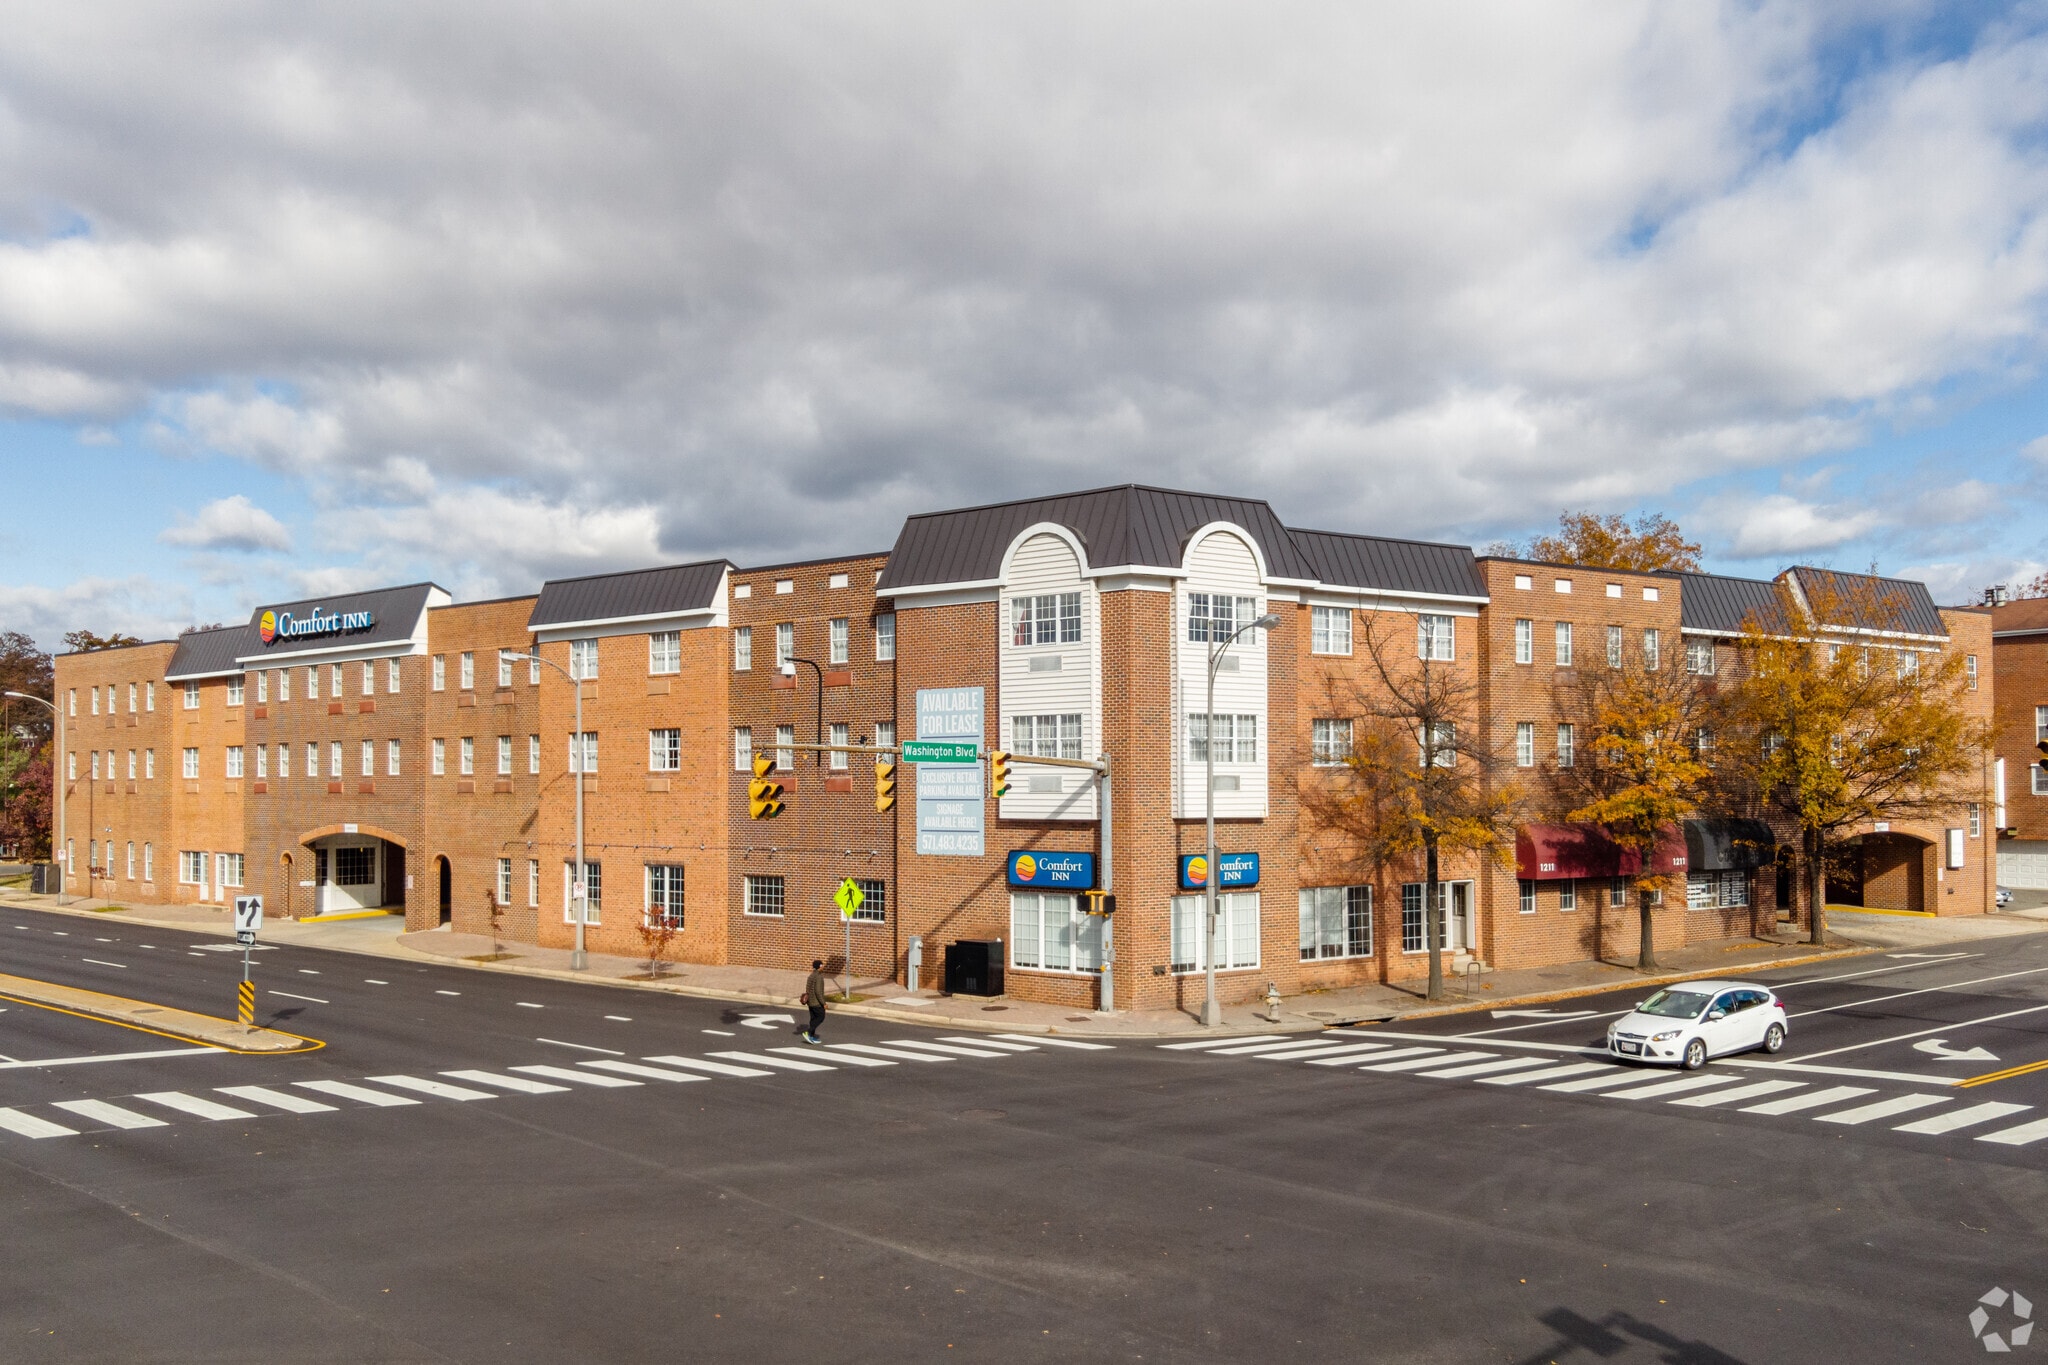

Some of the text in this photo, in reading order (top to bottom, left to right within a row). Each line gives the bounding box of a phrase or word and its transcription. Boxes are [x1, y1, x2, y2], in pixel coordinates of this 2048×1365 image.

[280, 607, 371, 637] Comfort INN
[922, 692, 978, 712] AVAILABLE
[922, 714, 978, 734] FOR LEASE
[904, 745, 976, 759] Washington Blvd.
[921, 771, 978, 784] EXCLUSIVE RETAIL
[919, 785, 981, 796] PARKING AVAILABLE
[936, 803, 964, 815] SIGNAGE
[923, 816, 977, 828] AVAILABLE HERE!
[922, 834, 978, 850] 571.483.4235
[1039, 857, 1083, 872] Comfort
[1219, 857, 1254, 871] omfort
[1540, 863, 1555, 872] 1211
[1673, 857, 1686, 866] 1211
[1051, 871, 1070, 881] INN
[1223, 871, 1242, 881] INN
